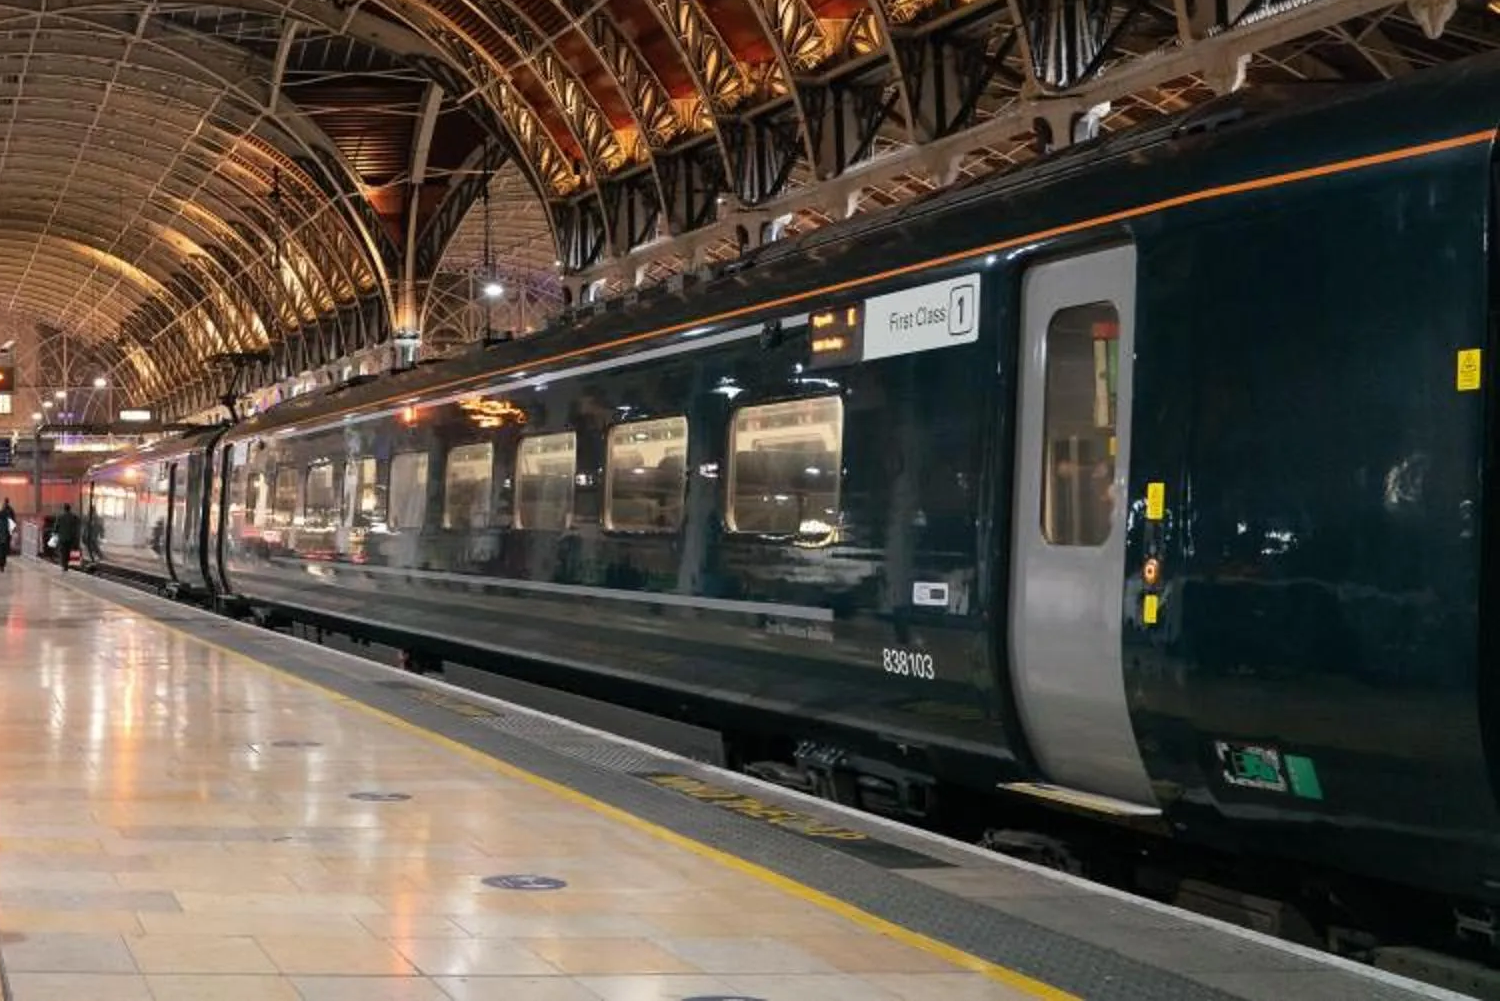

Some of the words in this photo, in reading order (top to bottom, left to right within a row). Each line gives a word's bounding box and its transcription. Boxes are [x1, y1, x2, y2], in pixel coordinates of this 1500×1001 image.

[889, 311, 914, 333] First
[915, 305, 947, 326] Class
[882, 647, 935, 680] 838103
